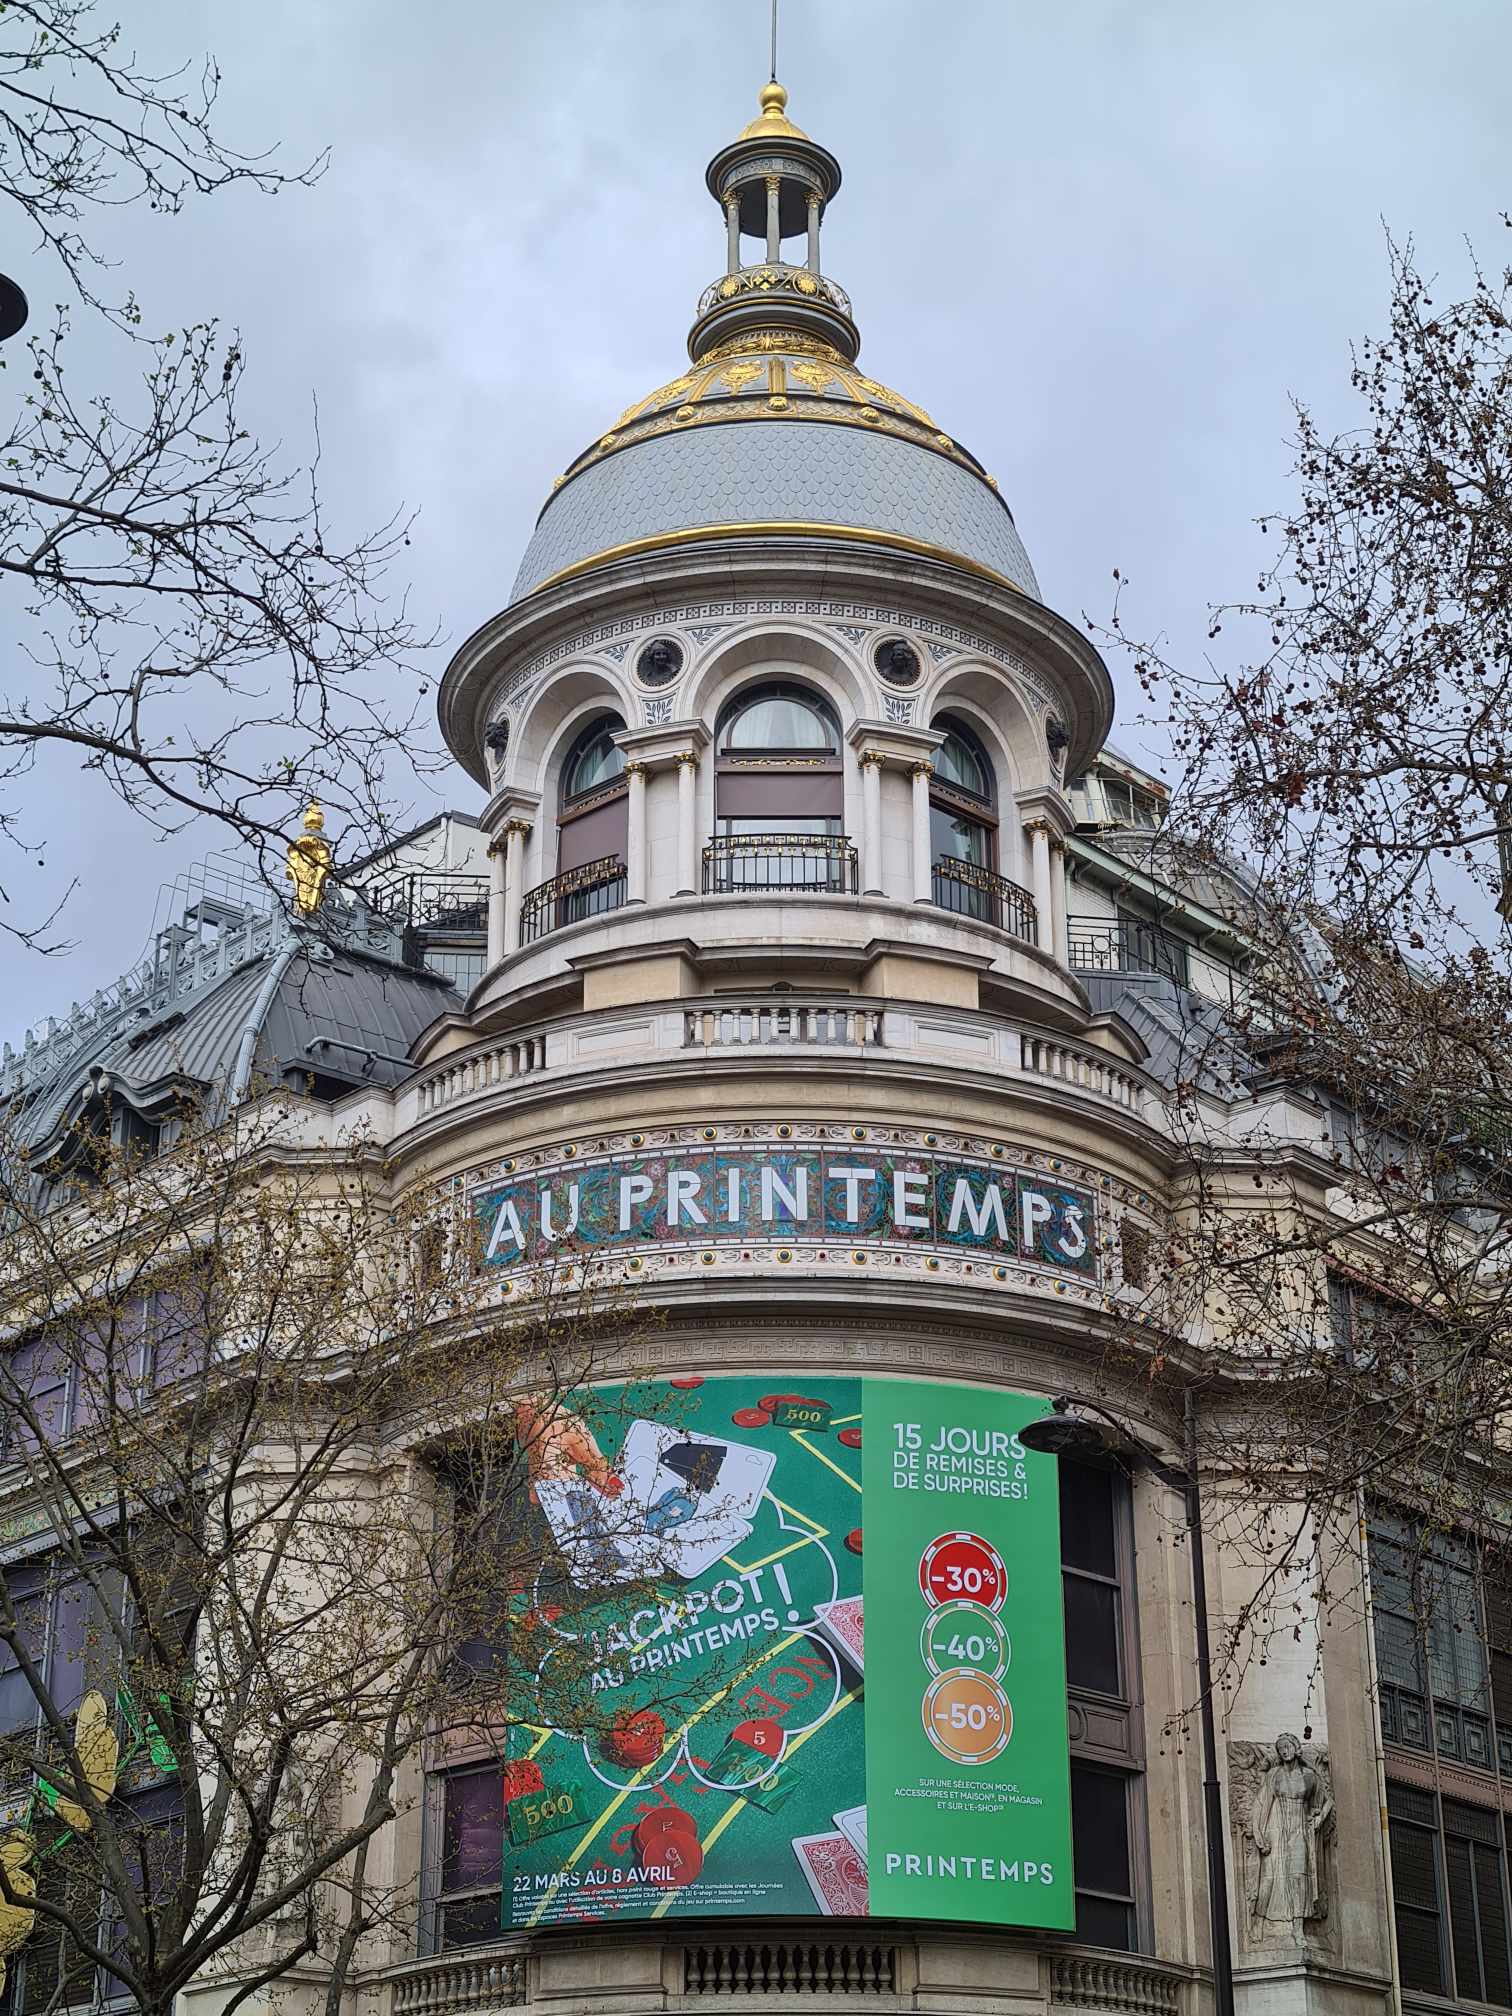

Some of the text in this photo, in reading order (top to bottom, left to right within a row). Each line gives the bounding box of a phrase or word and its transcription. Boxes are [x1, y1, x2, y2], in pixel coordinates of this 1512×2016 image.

[485, 1166, 1086, 1260] AU PRINTEMPS
[786, 1408, 821, 1423] 500
[893, 1423, 1026, 1460] 15 JOURS
[893, 1451, 1026, 1480] DE REMISES &
[893, 1471, 1028, 1500] DE SURPRISES!
[931, 1565, 996, 1594] -30%
[590, 1608, 780, 1696] AU PRINTEMPS
[933, 1634, 999, 1661] -40%
[935, 1703, 1000, 1730] -50%
[753, 1731, 766, 1745] 5
[895, 1788, 949, 1799] ACCESSOIRES
[949, 1791, 959, 1799] ET
[998, 1794, 1008, 1802] EN
[1009, 1795, 1043, 1805] MAGASIN
[920, 1778, 1020, 1793] SUR UNE SÉLECTION MODE,
[523, 1795, 573, 1825] 500
[947, 1802, 964, 1811] SUR
[512, 1865, 677, 1893] 22 MARS AU 8 AVRIL
[885, 1853, 1054, 1886] PRINTEMPS
